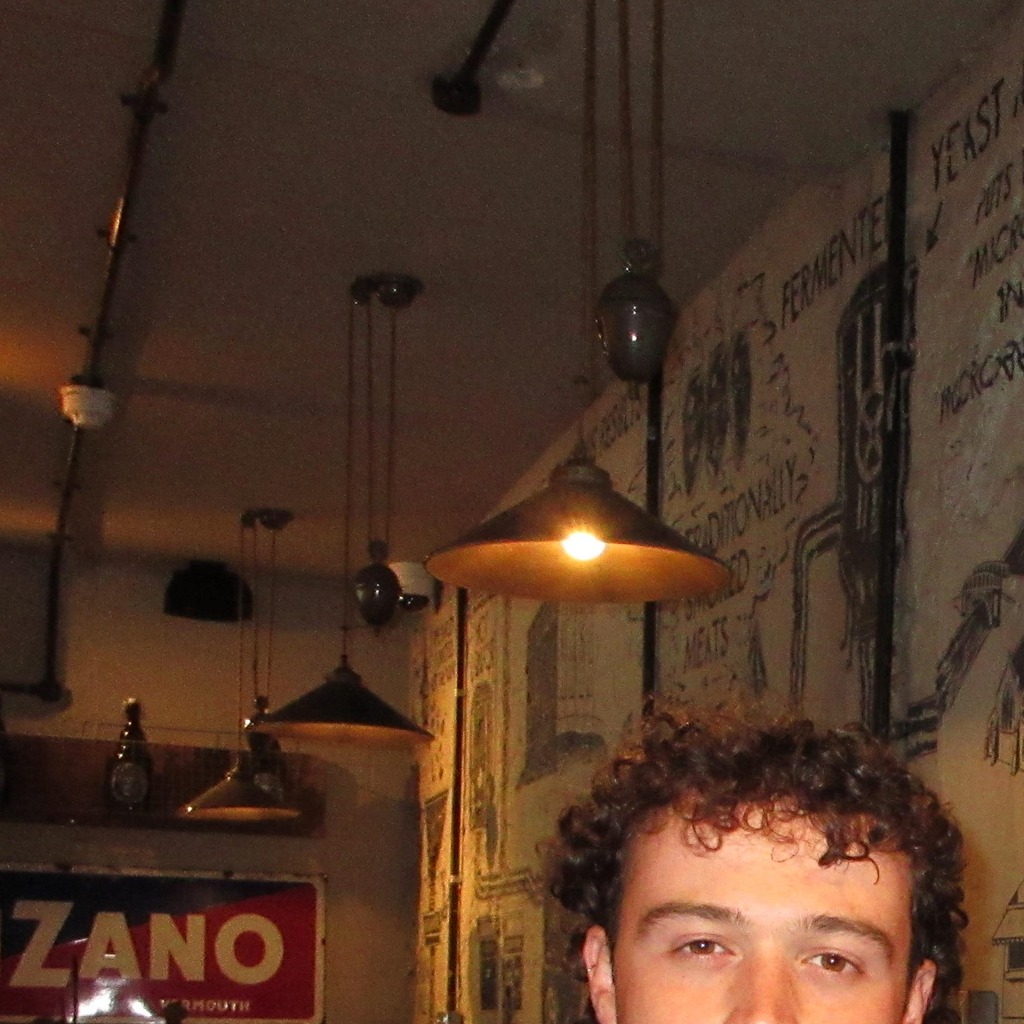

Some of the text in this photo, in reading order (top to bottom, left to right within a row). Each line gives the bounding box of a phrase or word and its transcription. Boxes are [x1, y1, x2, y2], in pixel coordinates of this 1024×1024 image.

[931, 78, 1005, 191] YEAST
[780, 197, 884, 331] FERMENTE
[9, 900, 284, 986] ZANO
[160, 999, 250, 1012] VRMOUTH
